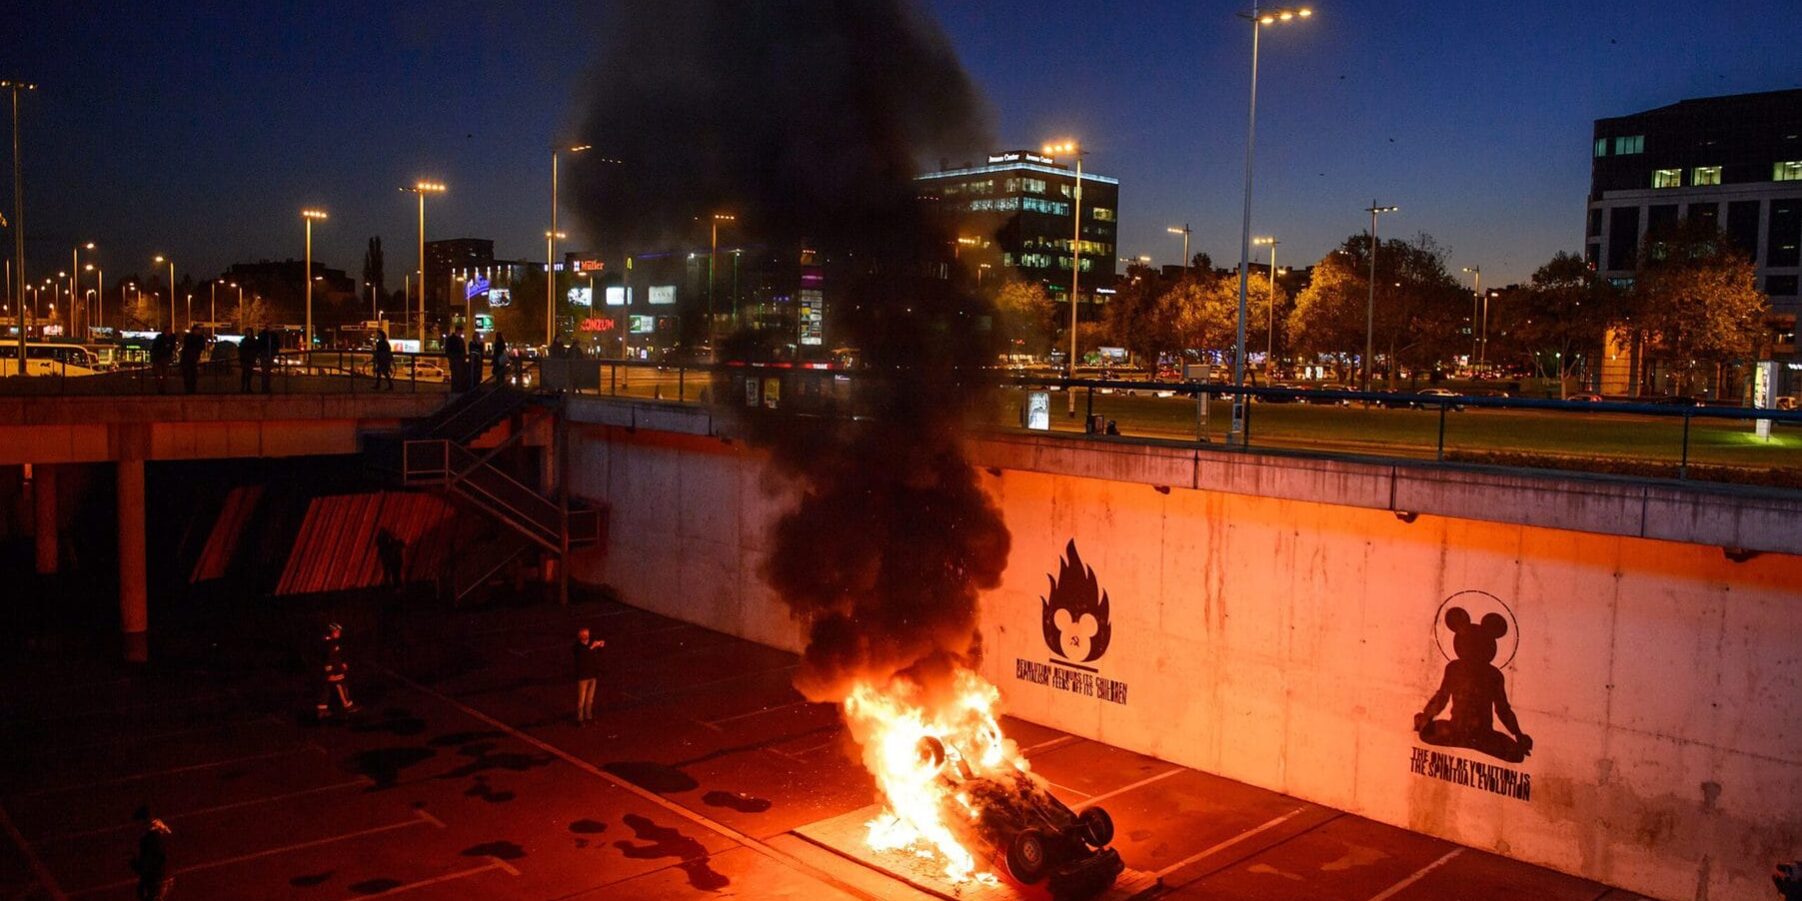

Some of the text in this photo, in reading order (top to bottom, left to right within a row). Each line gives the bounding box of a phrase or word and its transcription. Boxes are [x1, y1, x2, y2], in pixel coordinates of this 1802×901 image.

[1410, 758, 1426, 776] THE
[1478, 773, 1531, 802] EVOLUTION
[1411, 747, 1429, 761] THE
[1431, 751, 1455, 768] ONLY
[1520, 772, 1531, 785] IS
